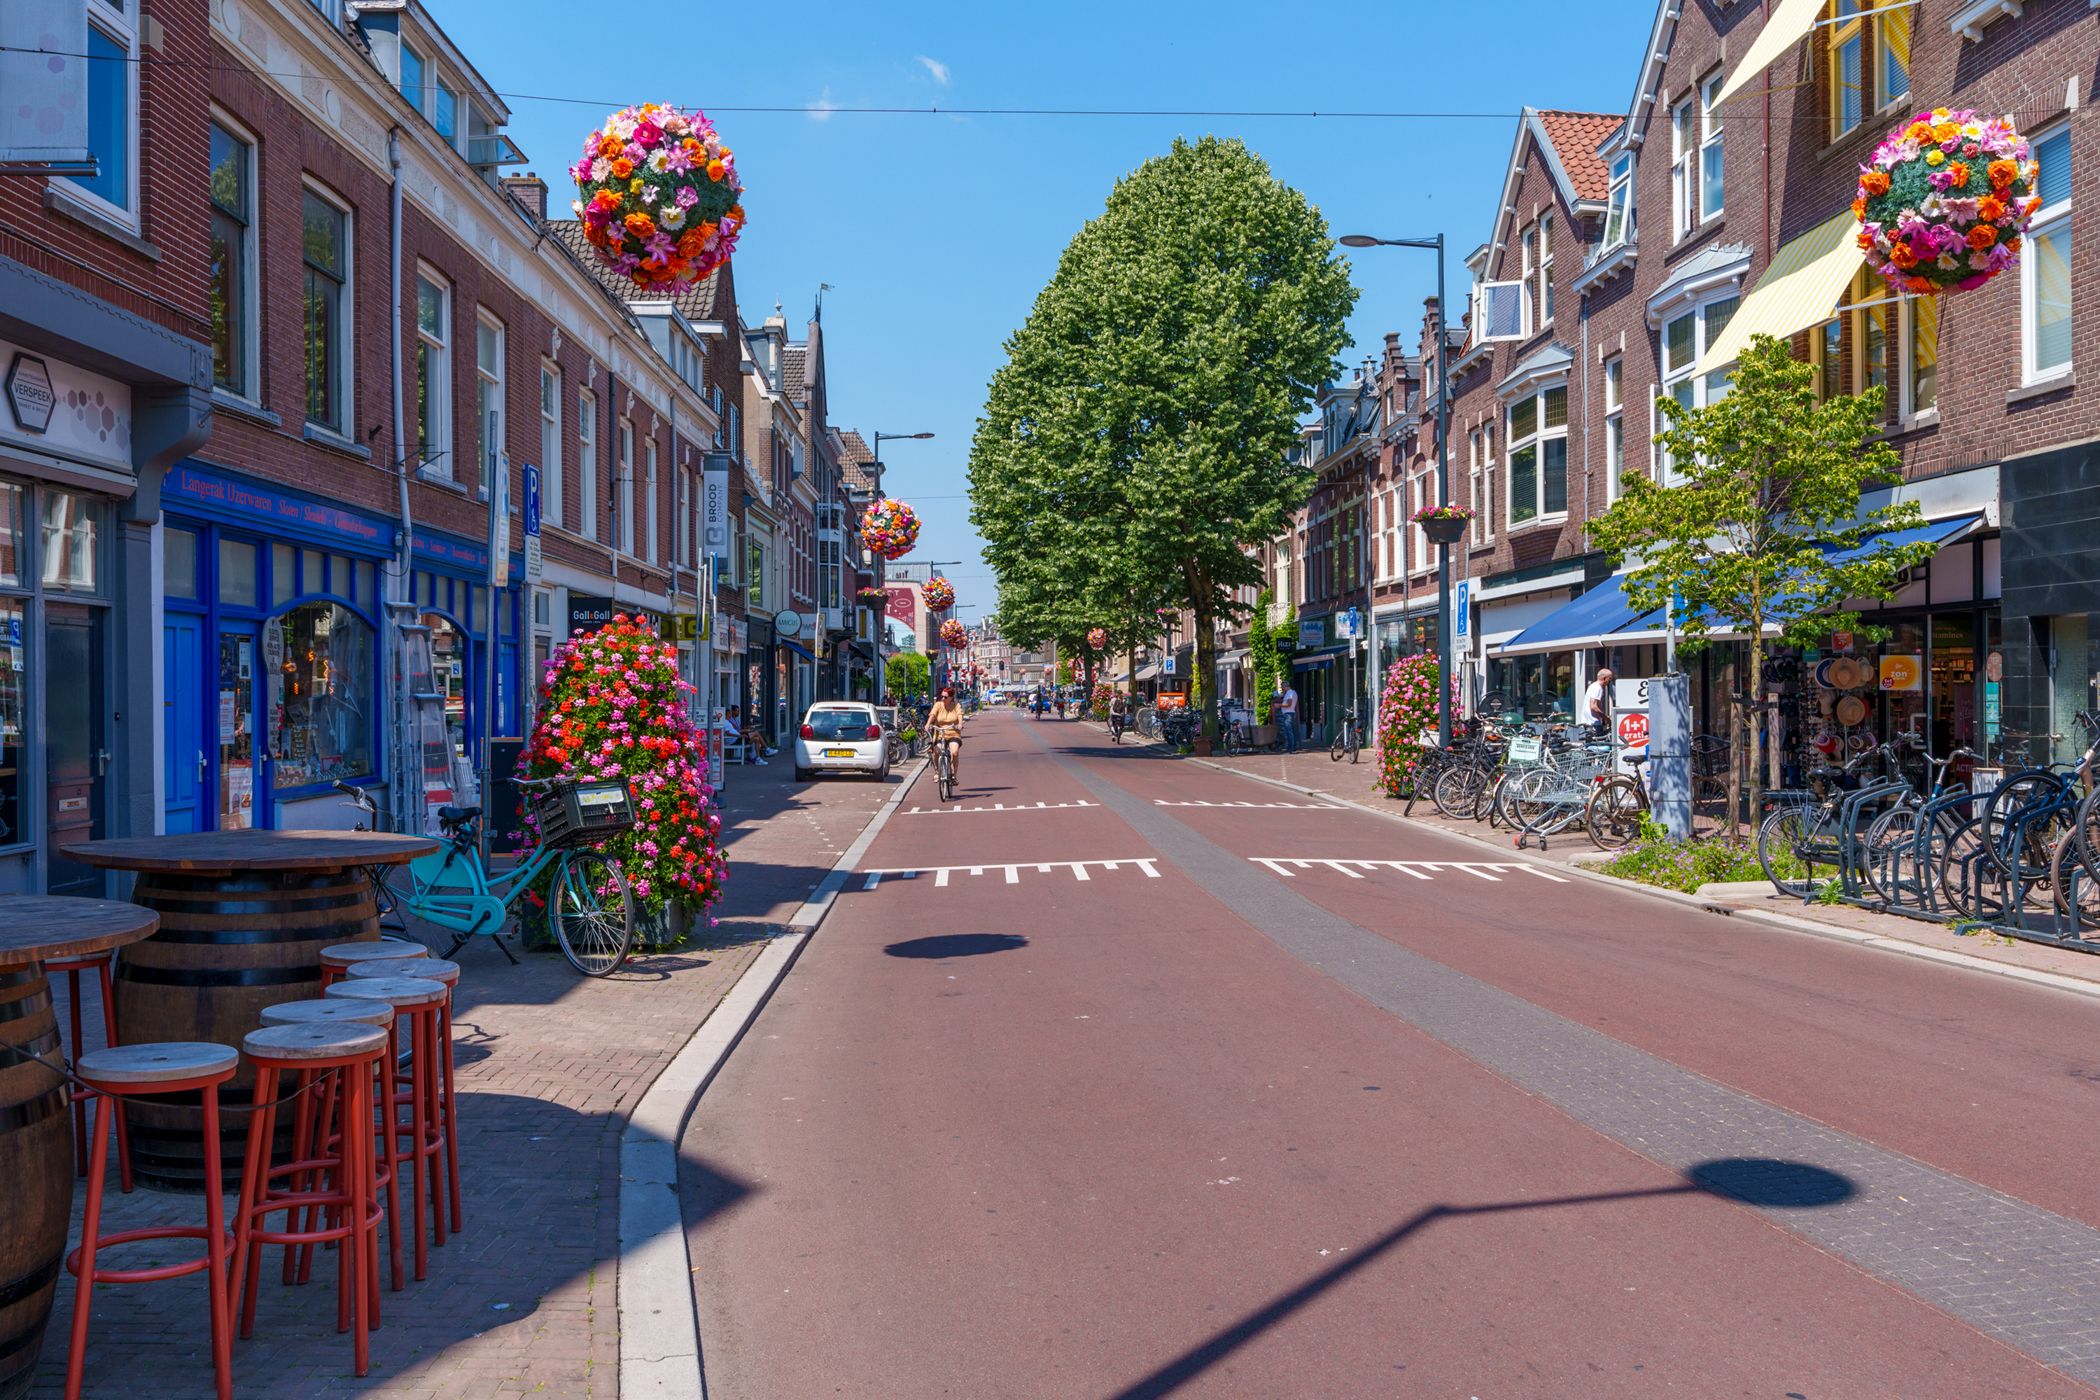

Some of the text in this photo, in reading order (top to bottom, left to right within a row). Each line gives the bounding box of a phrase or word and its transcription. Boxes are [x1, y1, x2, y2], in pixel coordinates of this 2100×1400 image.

[14, 382, 51, 403] VERSPEEK
[181, 469, 225, 499] Langerak
[530, 470, 537, 504] P
[709, 484, 717, 523] BROOD
[1460, 586, 1466, 613] P
[1624, 719, 1647, 732] 1+1
